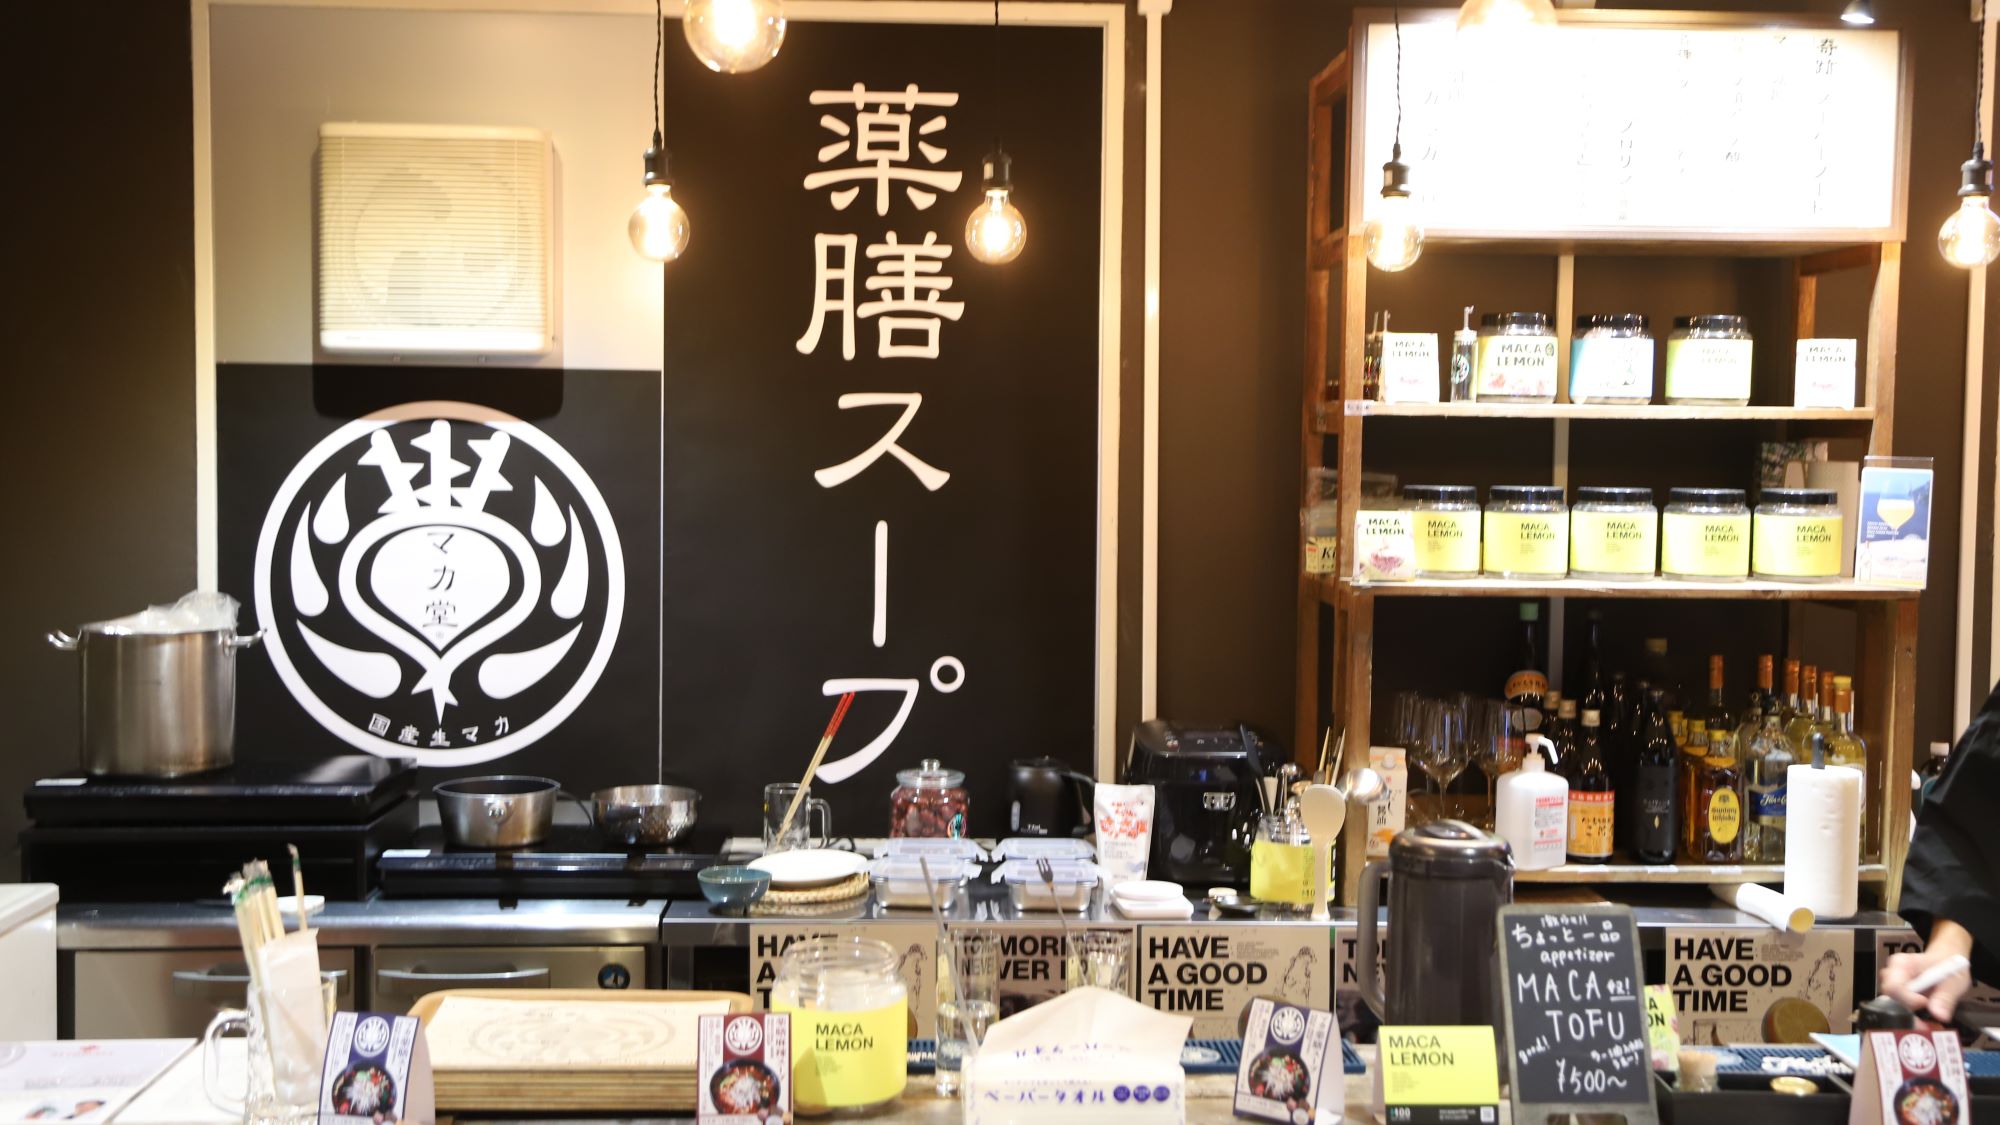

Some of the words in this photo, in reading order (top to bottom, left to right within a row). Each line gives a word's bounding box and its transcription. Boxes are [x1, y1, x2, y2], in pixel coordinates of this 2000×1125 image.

[1501, 344, 1542, 354] MACA
[1497, 356, 1545, 367] LEMON
[796, 82, 965, 784] 薬膳スープ
[1368, 518, 1401, 526] MACA
[1427, 520, 1457, 528] MACA
[1521, 523, 1550, 531] MACA
[1607, 522, 1636, 530] MACA
[1705, 525, 1734, 533] MACA
[1796, 525, 1827, 533] MACA
[1365, 527, 1405, 535] LEMON
[1427, 530, 1463, 538] LEMON
[1520, 532, 1555, 540] LEMON
[1606, 531, 1642, 540] LEMON
[1704, 534, 1739, 542] LEMON
[1796, 535, 1832, 543] LEMON
[422, 532, 459, 628] マカ堂
[367, 712, 511, 748] 国産生マカ
[1511, 920, 1620, 949] ちょっと一品
[1149, 936, 1230, 959] HAVE
[1673, 938, 1754, 961] HAVE
[1540, 947, 1615, 968] appetizer
[1148, 963, 1169, 985] A
[1176, 962, 1268, 986] GOOD
[1672, 964, 1694, 986] A
[1701, 964, 1792, 987] GOOD
[1517, 969, 1601, 1003] MACA
[1148, 988, 1224, 1011] TIME
[1672, 989, 1748, 1012] TIME
[815, 1023, 864, 1035] MACA
[1545, 1008, 1625, 1042] TOFU
[815, 1036, 874, 1051] LEMON
[1389, 1035, 1441, 1049] MACA
[1390, 1051, 1455, 1067] LEMON
[984, 1088, 1105, 1104] ペーパータオル
